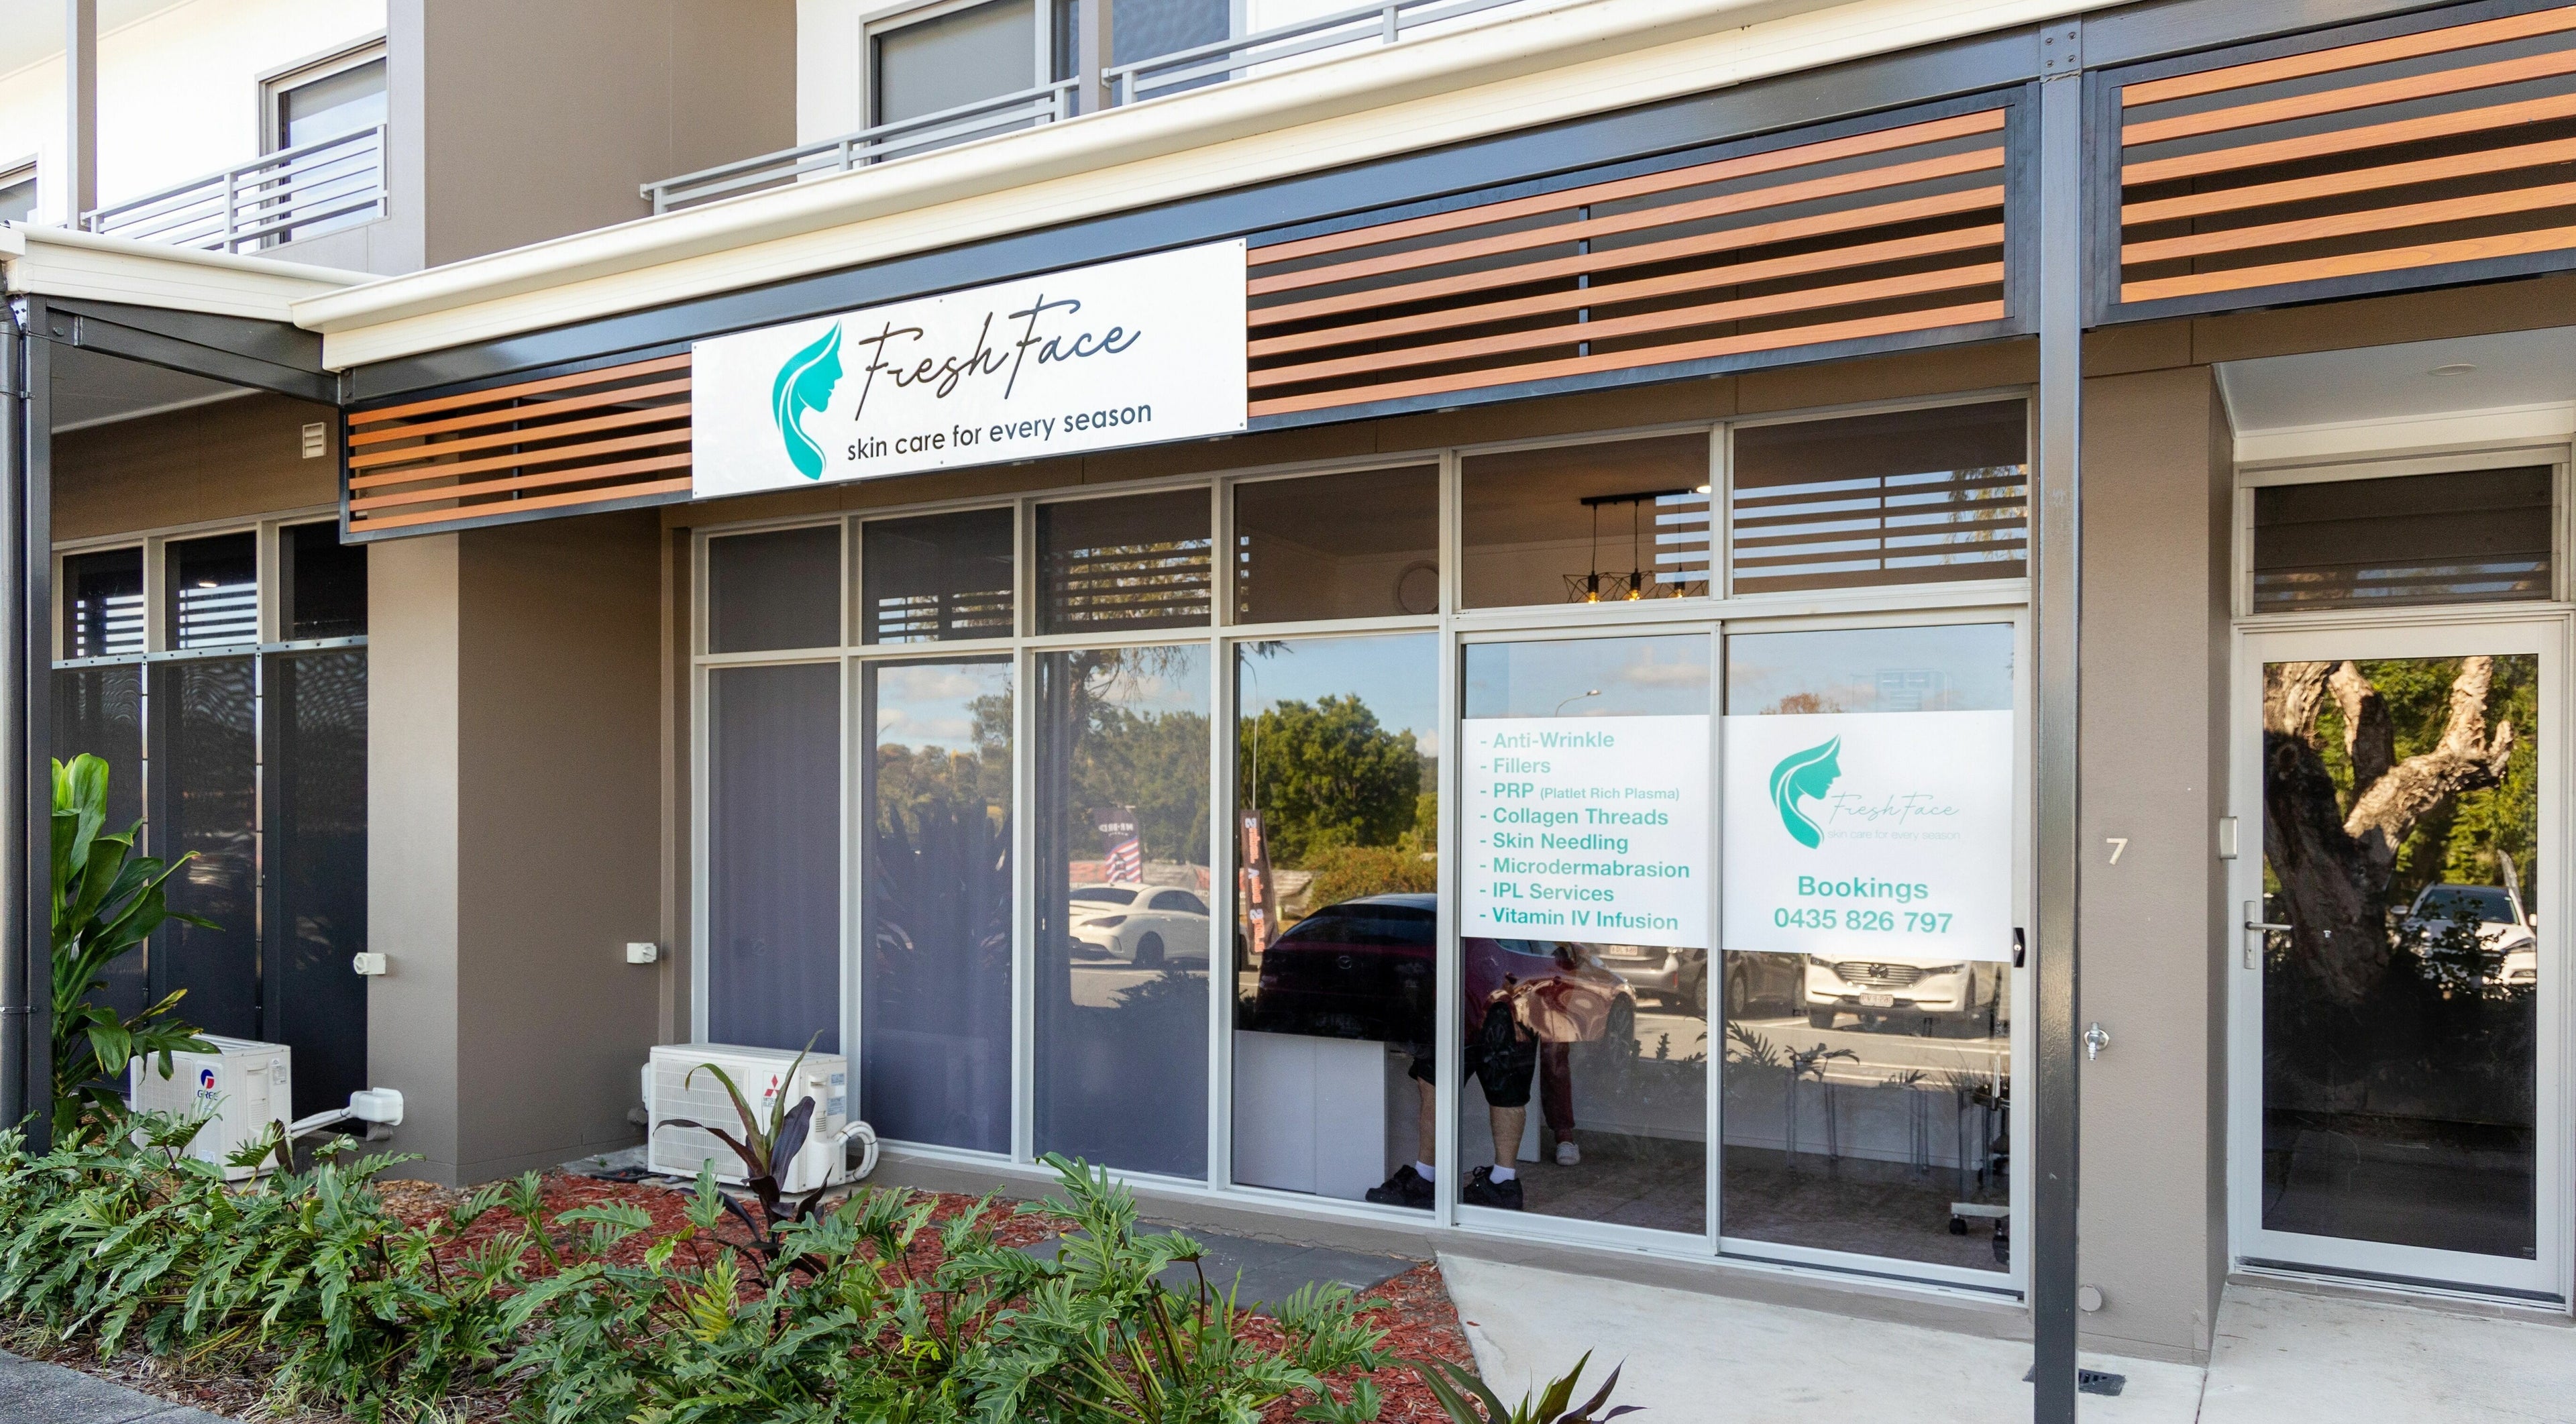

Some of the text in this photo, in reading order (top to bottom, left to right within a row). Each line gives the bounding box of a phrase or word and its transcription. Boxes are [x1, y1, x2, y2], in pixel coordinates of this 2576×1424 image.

[848, 404, 1151, 460] skin care for every season
[1494, 732, 1614, 748] Anti-Wrinkle
[1494, 757, 1550, 773] Fillers
[1493, 783, 1679, 801] PRP (Platlet Rich Plasma)
[1493, 808, 1668, 827] Collagen Threads
[1493, 832, 1628, 855] Skin Needling
[1828, 830, 1847, 838] skin
[1874, 830, 1888, 838] for
[1891, 831, 1919, 841] every
[1922, 832, 1960, 840] season
[2106, 838, 2128, 865] 7
[1493, 858, 1689, 877] Microdermabrasion
[1493, 883, 1614, 901] IPL Services
[1799, 875, 1929, 903] Bookings
[1493, 908, 1678, 930] Vitamin IV Infusion
[1774, 908, 1953, 933] 0435 826 797
